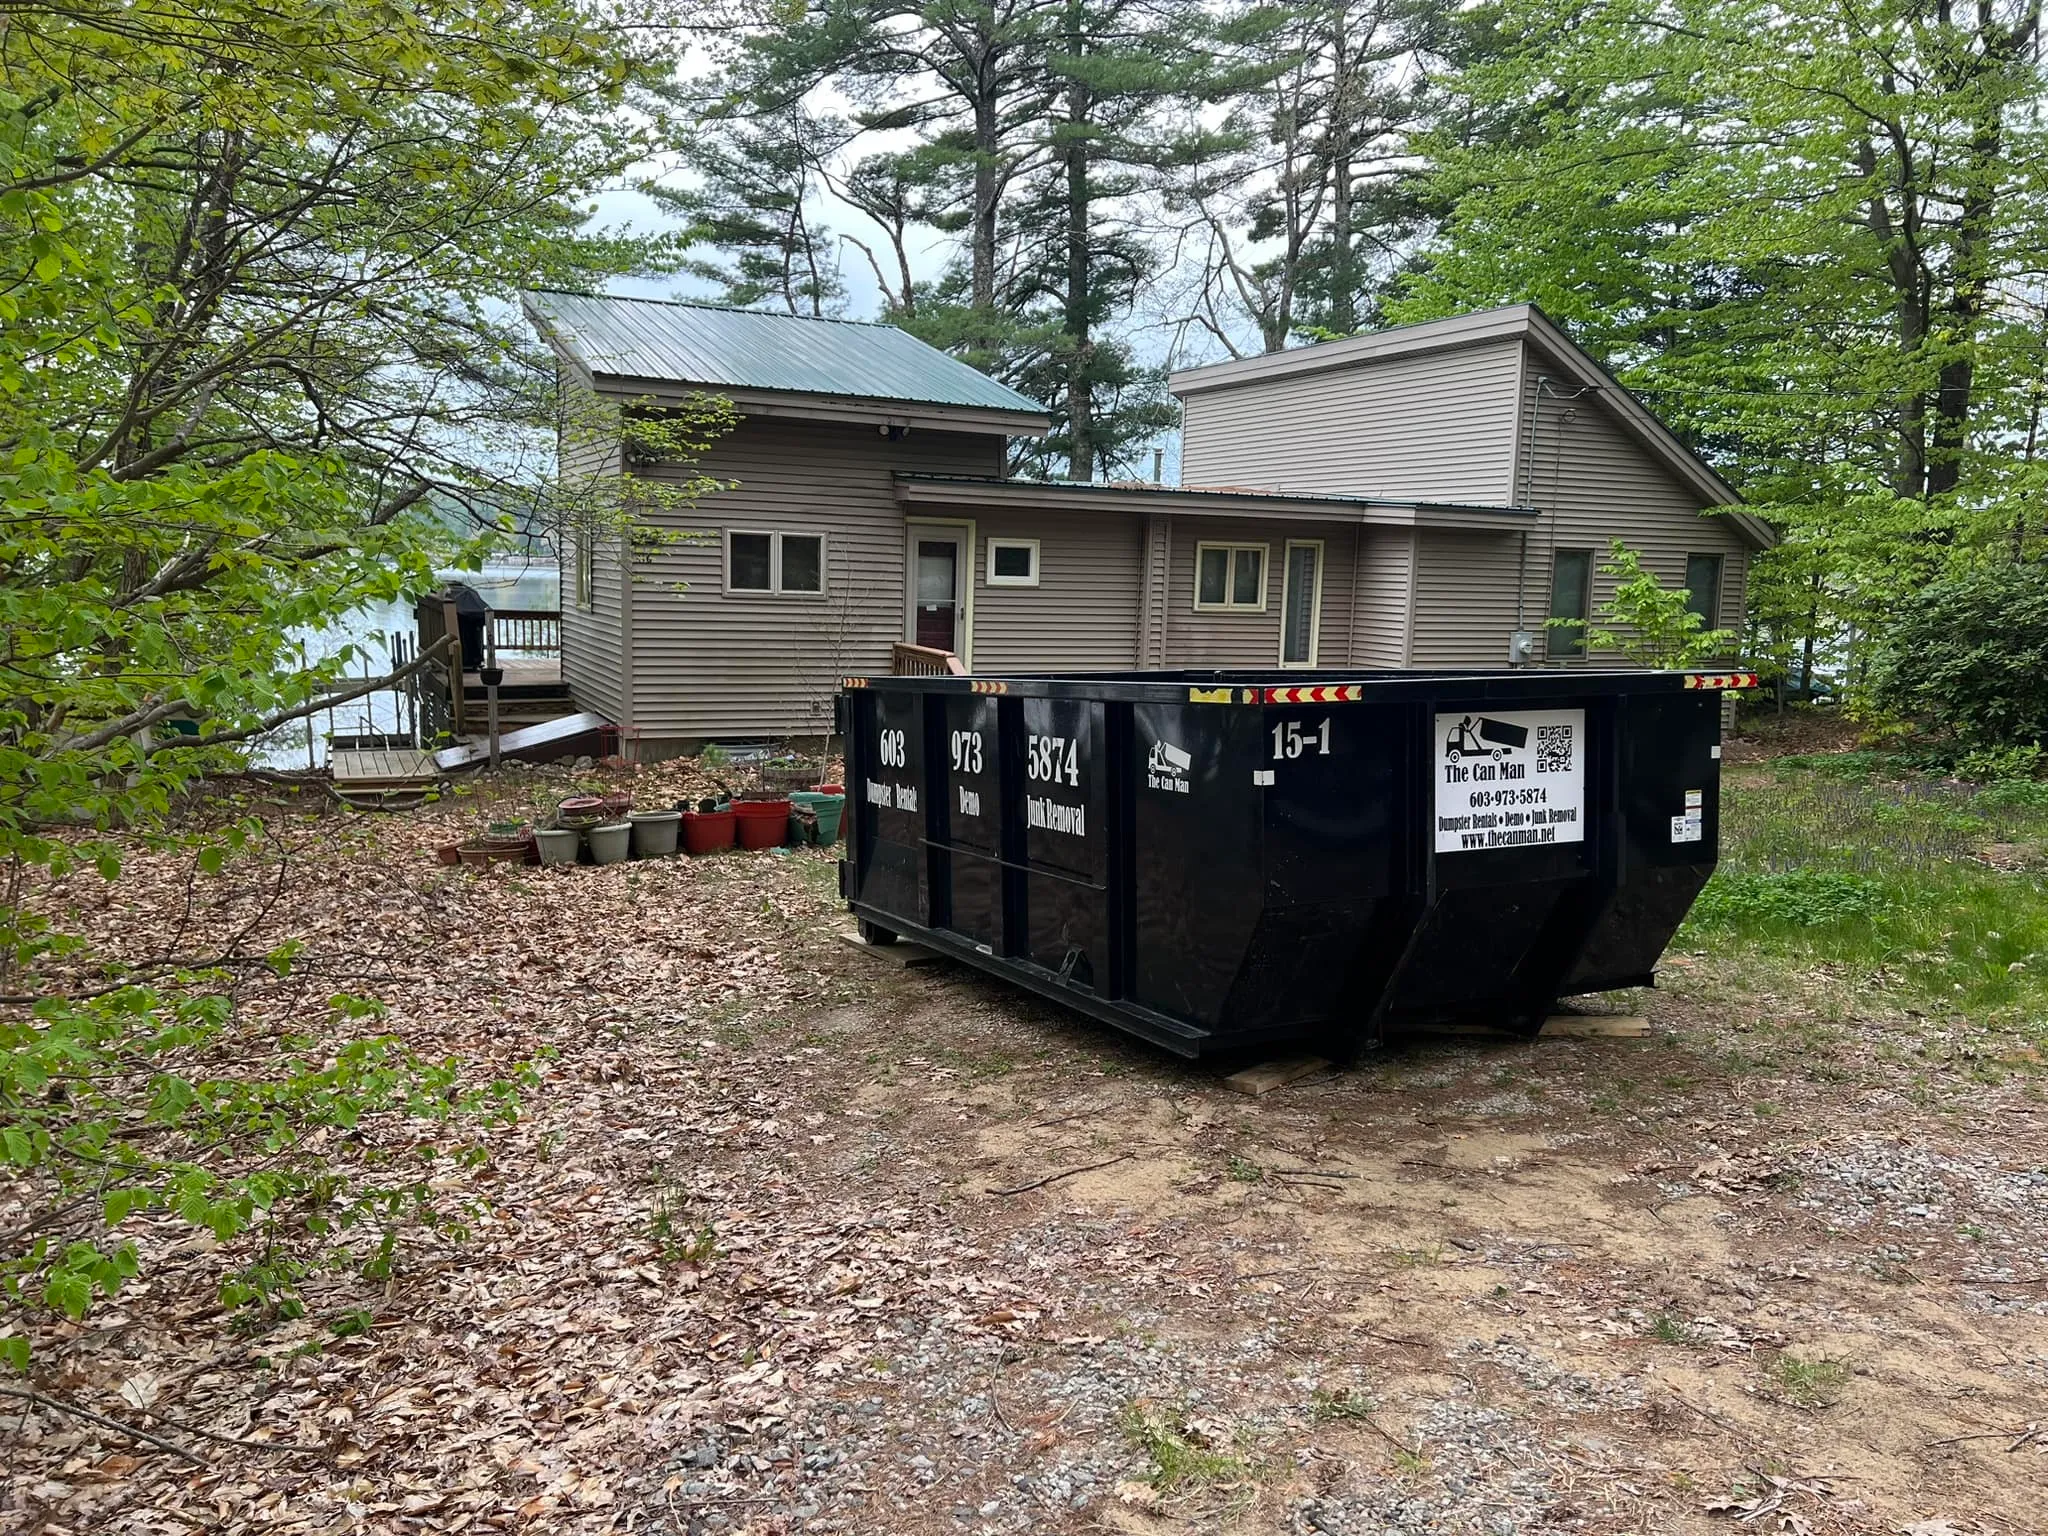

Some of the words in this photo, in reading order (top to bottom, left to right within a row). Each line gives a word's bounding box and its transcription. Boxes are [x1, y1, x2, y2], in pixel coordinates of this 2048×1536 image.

[1271, 717, 1331, 760] 15-1
[880, 729, 905, 768] 603
[951, 730, 983, 774] 973
[1027, 734, 1079, 786] 5874
[1148, 774, 1160, 789] The
[1161, 776, 1173, 791] Can
[1174, 778, 1189, 793] Man
[1444, 764, 1469, 783] The
[1473, 763, 1496, 782] Can
[1500, 761, 1525, 781] Man
[867, 777, 891, 808] Dumpster
[959, 785, 980, 816] Demo
[1026, 795, 1046, 829] Junk
[1046, 798, 1085, 836] Removal
[1438, 815, 1471, 832] Dumpster
[1472, 813, 1497, 829] Rentals
[1505, 811, 1524, 827] Demo
[1531, 809, 1547, 826] Junk
[1549, 807, 1577, 823] Removal
[1461, 826, 1555, 849] www.thecanman.net
